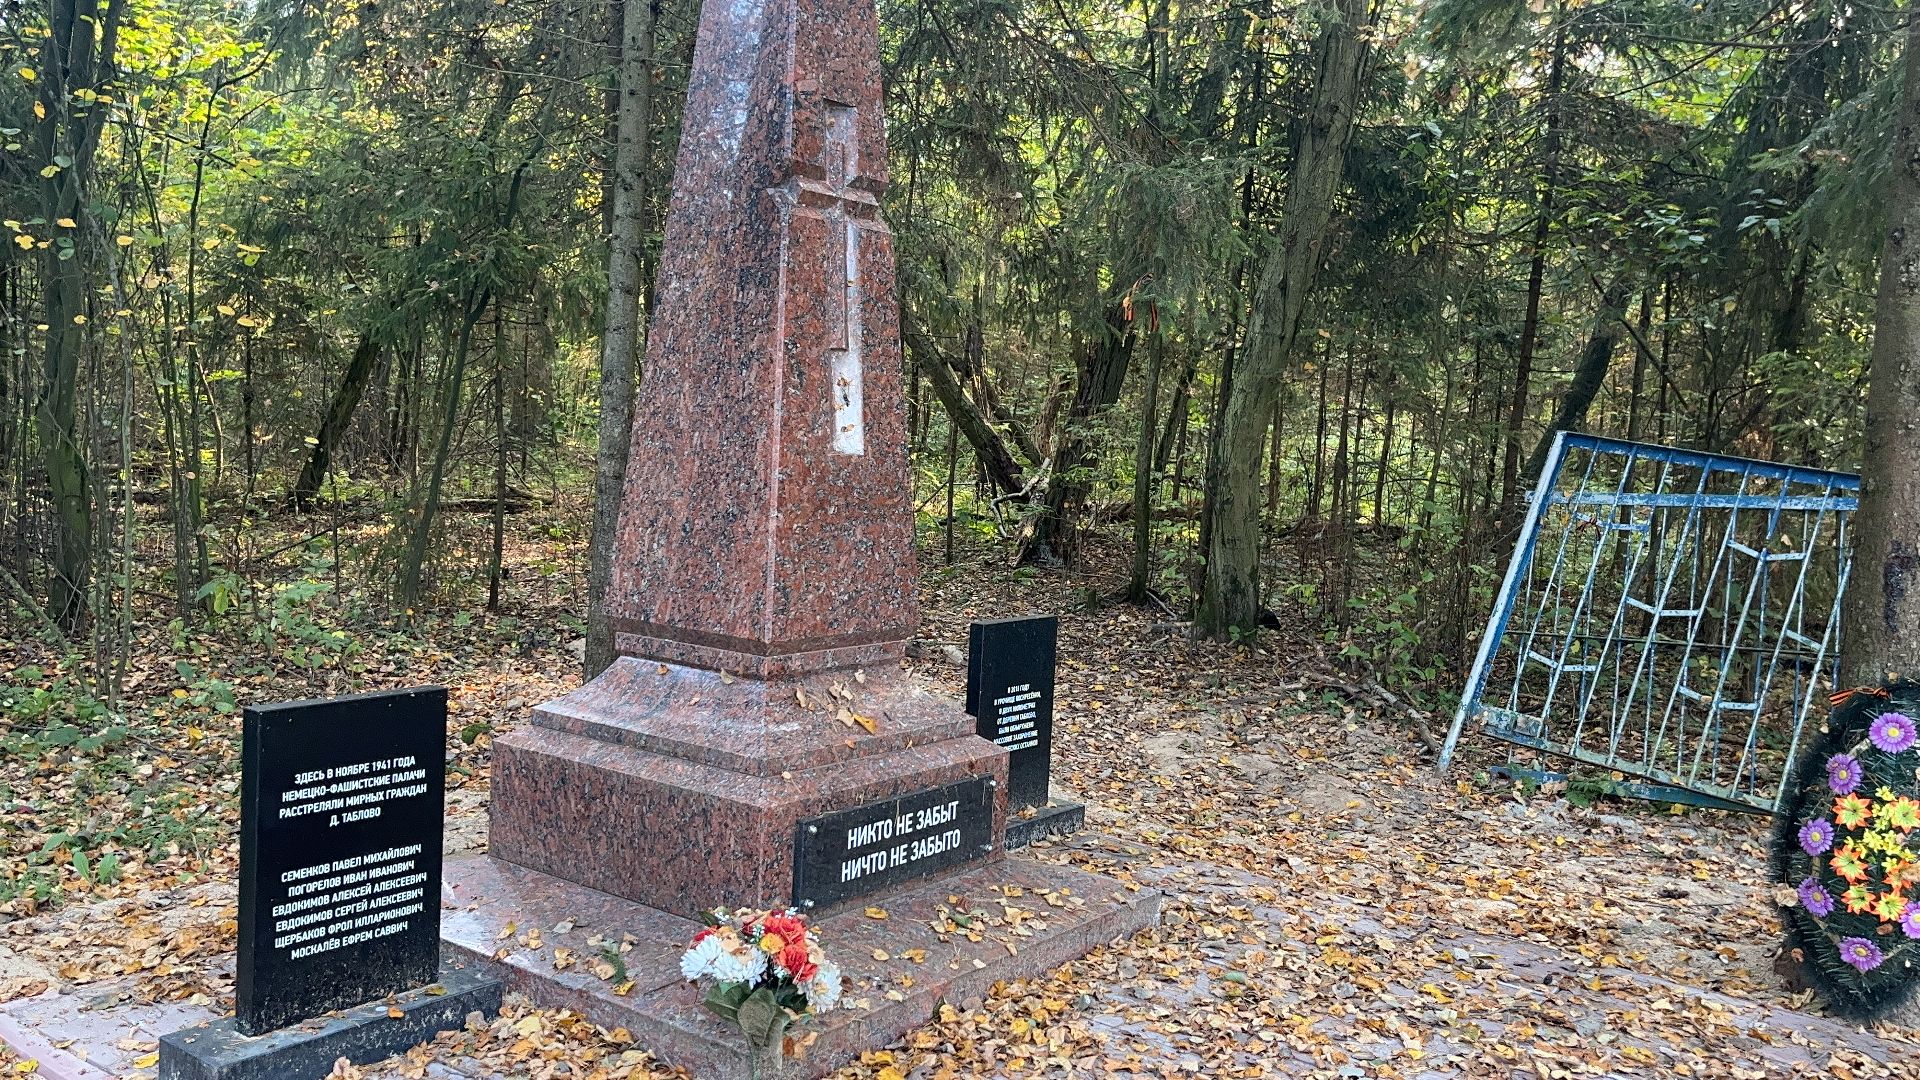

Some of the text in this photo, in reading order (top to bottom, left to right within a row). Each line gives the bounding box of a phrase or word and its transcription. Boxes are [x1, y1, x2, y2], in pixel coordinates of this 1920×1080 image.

[282, 769, 425, 802] НЕМЕЦКО-ФАШИСТСКИЕ ПАЛАЧИ
[294, 756, 415, 784] ЗДЕСЬ В НОЯБРЕ 1941 ГОДА
[279, 784, 427, 819] РАССТРЕЛЯЛИ МИРНЫХ ГРАЖДАН
[330, 807, 381, 827] Д. ТАБЛОВО
[848, 801, 959, 850] НИКТО НЕ ЗАБЫТ
[281, 844, 421, 882] СЕМЕНКОВ ПАВЕЛ МИХАЙЛОВИЧ
[842, 829, 960, 882] НИЧТО НЕ ЗАБЫТО
[272, 872, 427, 916] ЕВДОКИМОВ АЛЕКСЕЙ АЛЕКСЕЕВИЧ
[288, 860, 415, 897] ПОГОРЕЛОВ ИВАН ИВАНОВИЧ
[274, 903, 423, 948] ЩЕРБАКОВ ФРОЛ ИЛЛАРИОНОВИЧ
[276, 888, 423, 932] ЕВДОКИМОВ СЕРГЕЙ АЛЕКСЕЕВИЧ
[291, 921, 408, 960] МОСКАЛЁВ ЕФРЕМ САВВИЧ
